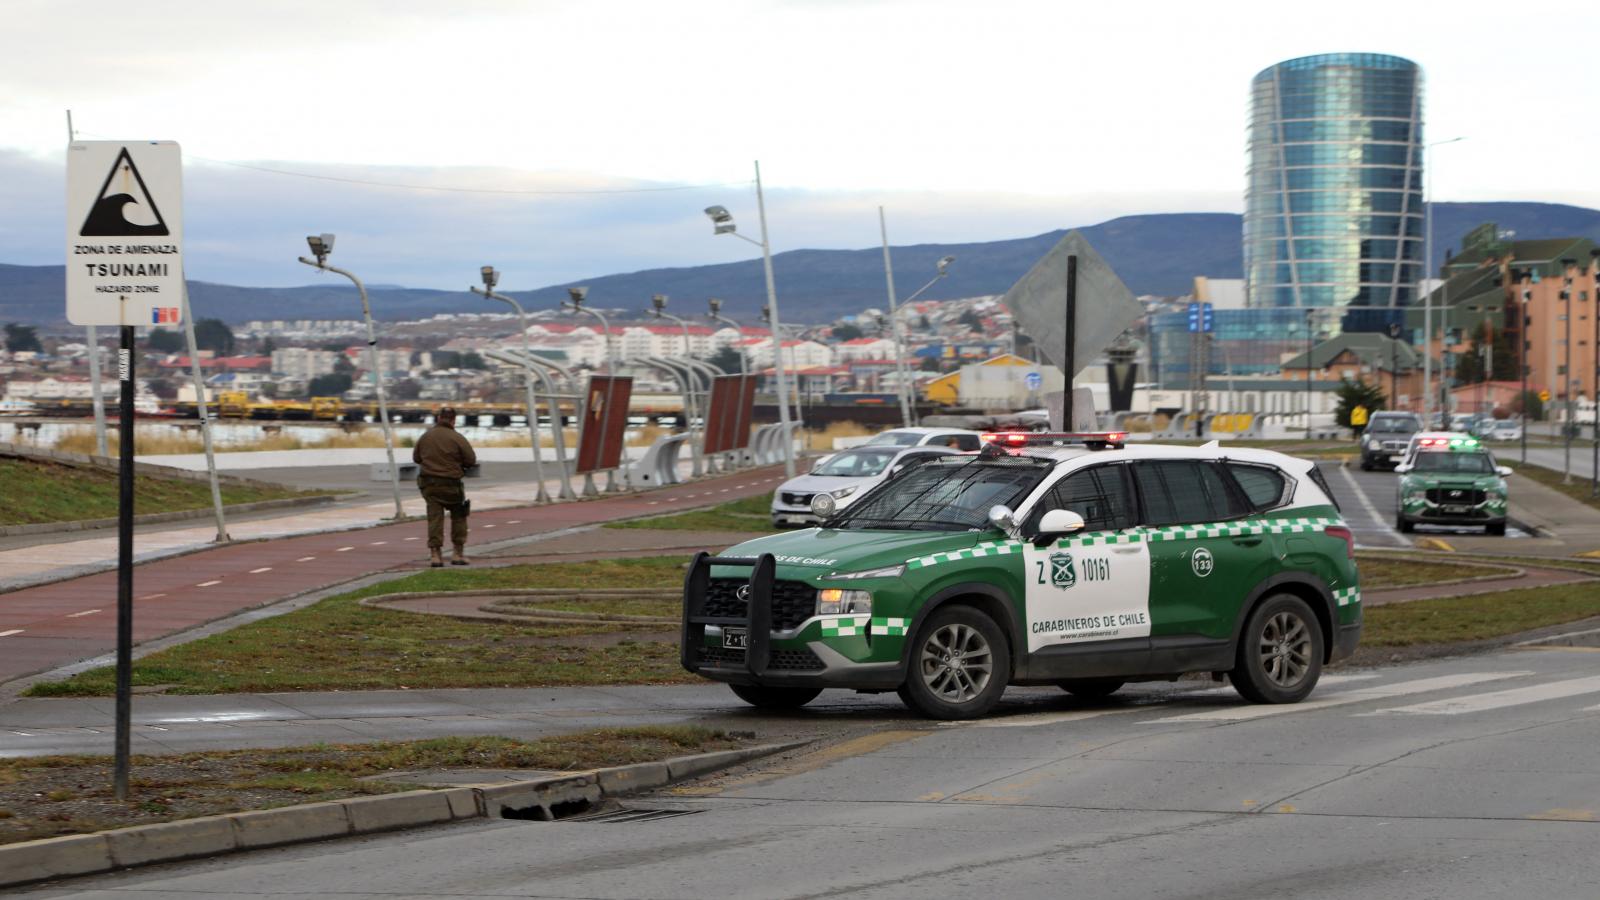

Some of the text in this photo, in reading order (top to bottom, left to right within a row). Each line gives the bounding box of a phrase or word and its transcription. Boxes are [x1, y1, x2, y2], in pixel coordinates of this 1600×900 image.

[74, 245, 178, 254] ZONA DE AMENAZA
[86, 263, 168, 276] TSUNAMI
[96, 285, 160, 293] HAZARD ZONE
[802, 558, 837, 566] CHILE
[1194, 560, 1211, 570] 133
[1036, 558, 1110, 584] Z 10161
[1032, 613, 1146, 634] CARABINEROS DE CHILE
[1060, 629, 1119, 640] www.carabineros.cl
